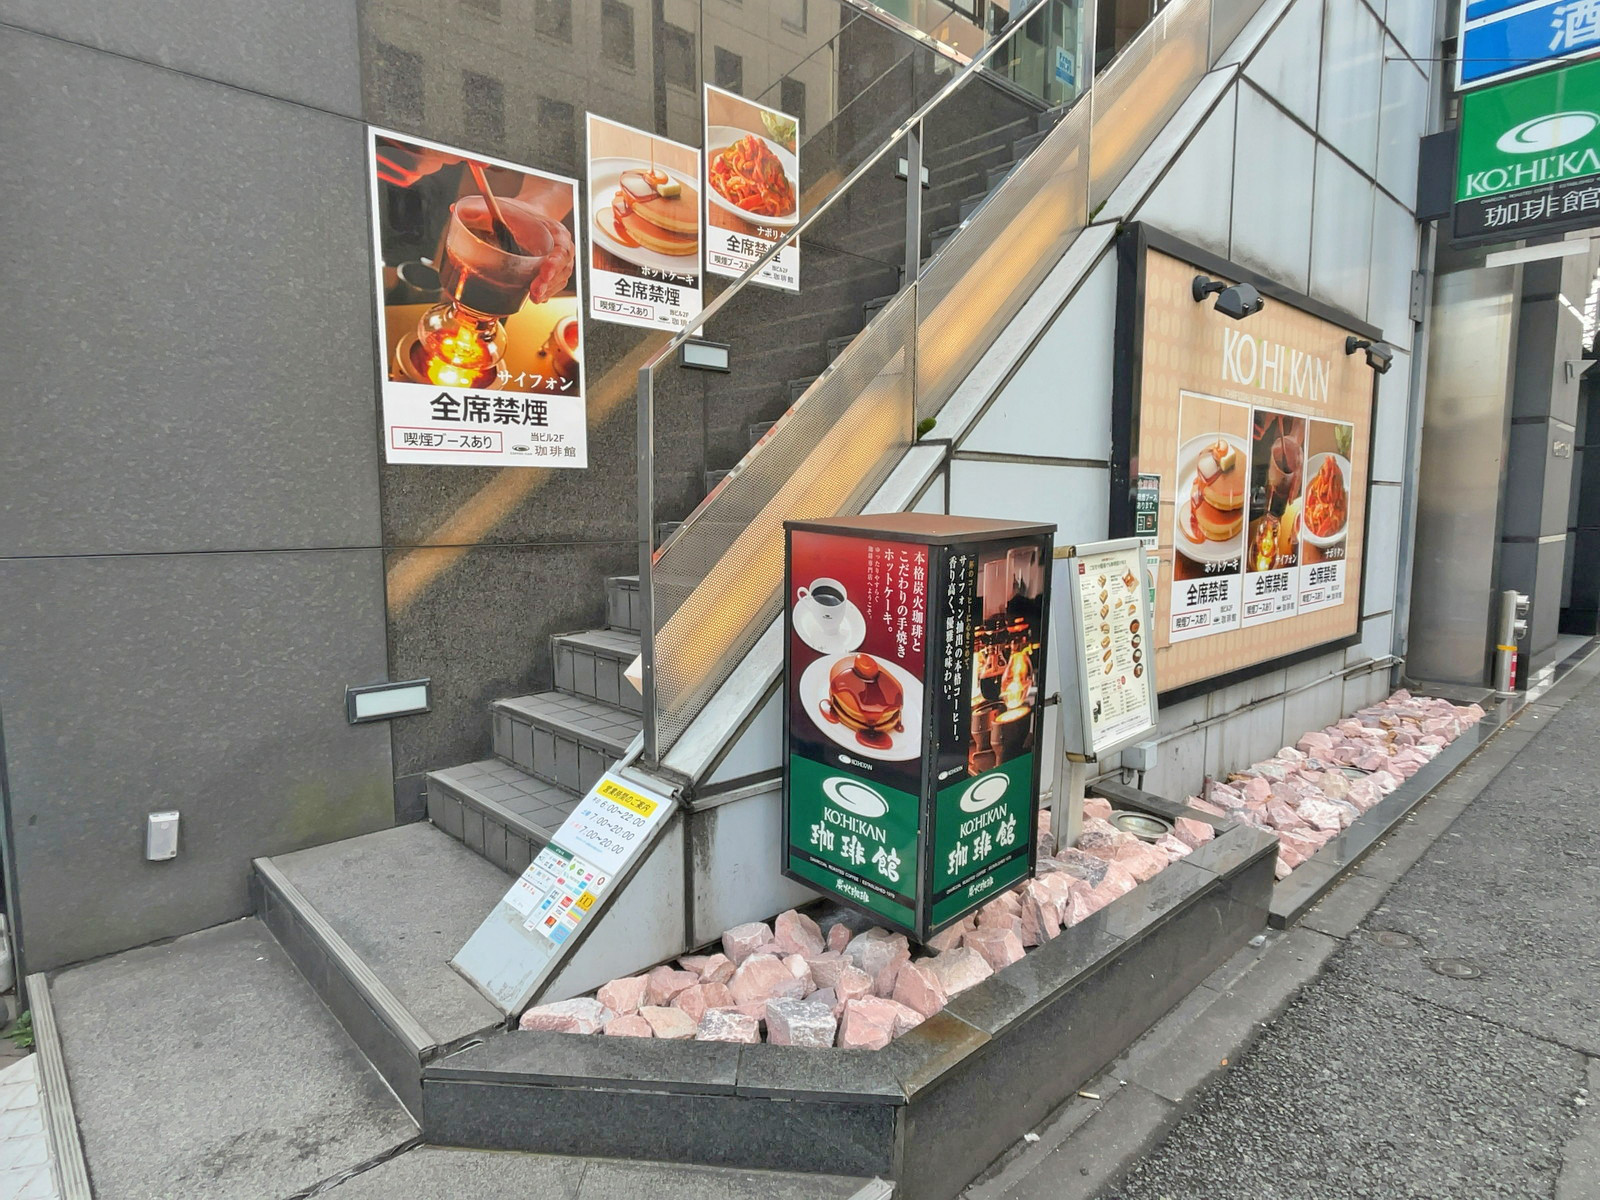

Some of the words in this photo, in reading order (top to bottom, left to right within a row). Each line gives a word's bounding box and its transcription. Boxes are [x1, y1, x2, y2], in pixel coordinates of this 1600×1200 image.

[1548, 0, 1600, 51] 酒
[1484, 187, 1600, 227] 珈琲館
[641, 265, 694, 286] ホットケーキ
[615, 278, 680, 307] 全席禁煙
[600, 301, 648, 317] 喫煙ブースあり
[497, 369, 574, 392] サイフォン
[430, 392, 549, 427] 全席禁煙
[404, 432, 493, 450] 喫煙ブースあり
[531, 432, 564, 442] 当ビル2F
[535, 445, 576, 457] 珈琲館
[1204, 559, 1239, 573] ホットケーキ
[1309, 564, 1337, 586] 全席禁煙
[883, 548, 894, 632] ホットケーキ。
[1187, 580, 1228, 606] 全席禁煙
[1255, 572, 1289, 595] 全席禁煙
[896, 550, 909, 658] こだわりの手焼き
[911, 551, 925, 652] 本格炭火珈琲と
[603, 785, 651, 812] 営業時間のご案内
[810, 820, 901, 882] 珈琲館
[947, 813, 1016, 875] 珈琲館
